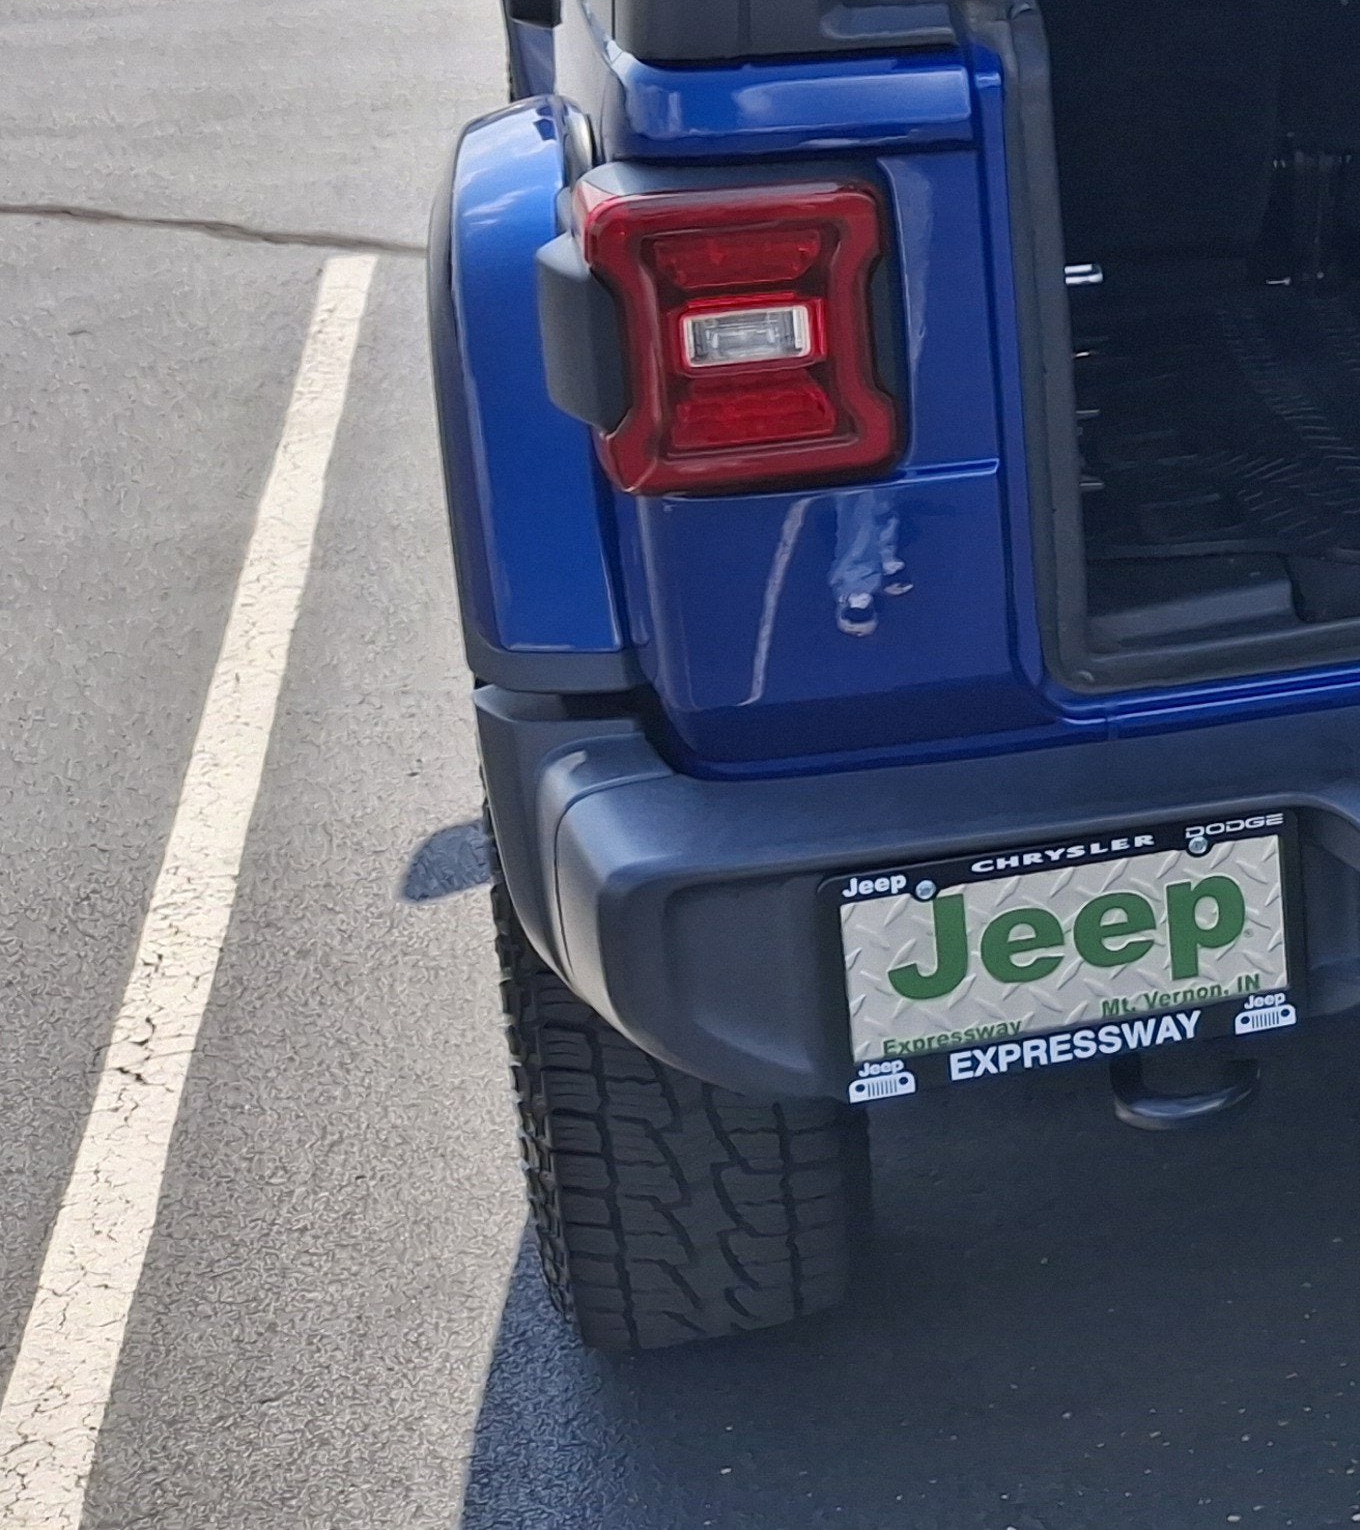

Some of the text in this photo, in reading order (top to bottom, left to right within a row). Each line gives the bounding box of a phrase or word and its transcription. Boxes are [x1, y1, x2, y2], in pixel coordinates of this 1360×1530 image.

[842, 812, 1284, 898] Jeep CHRYSLER DODGE
[887, 874, 1247, 1000] Jeep
[1101, 998, 1136, 1017] Mt.
[1236, 973, 1260, 993] IN
[1243, 992, 1286, 1010] Jeep
[883, 1019, 1022, 1057] Expressway
[950, 1010, 1201, 1082] EXPRESSWAY
[857, 1059, 904, 1078] Jeep
